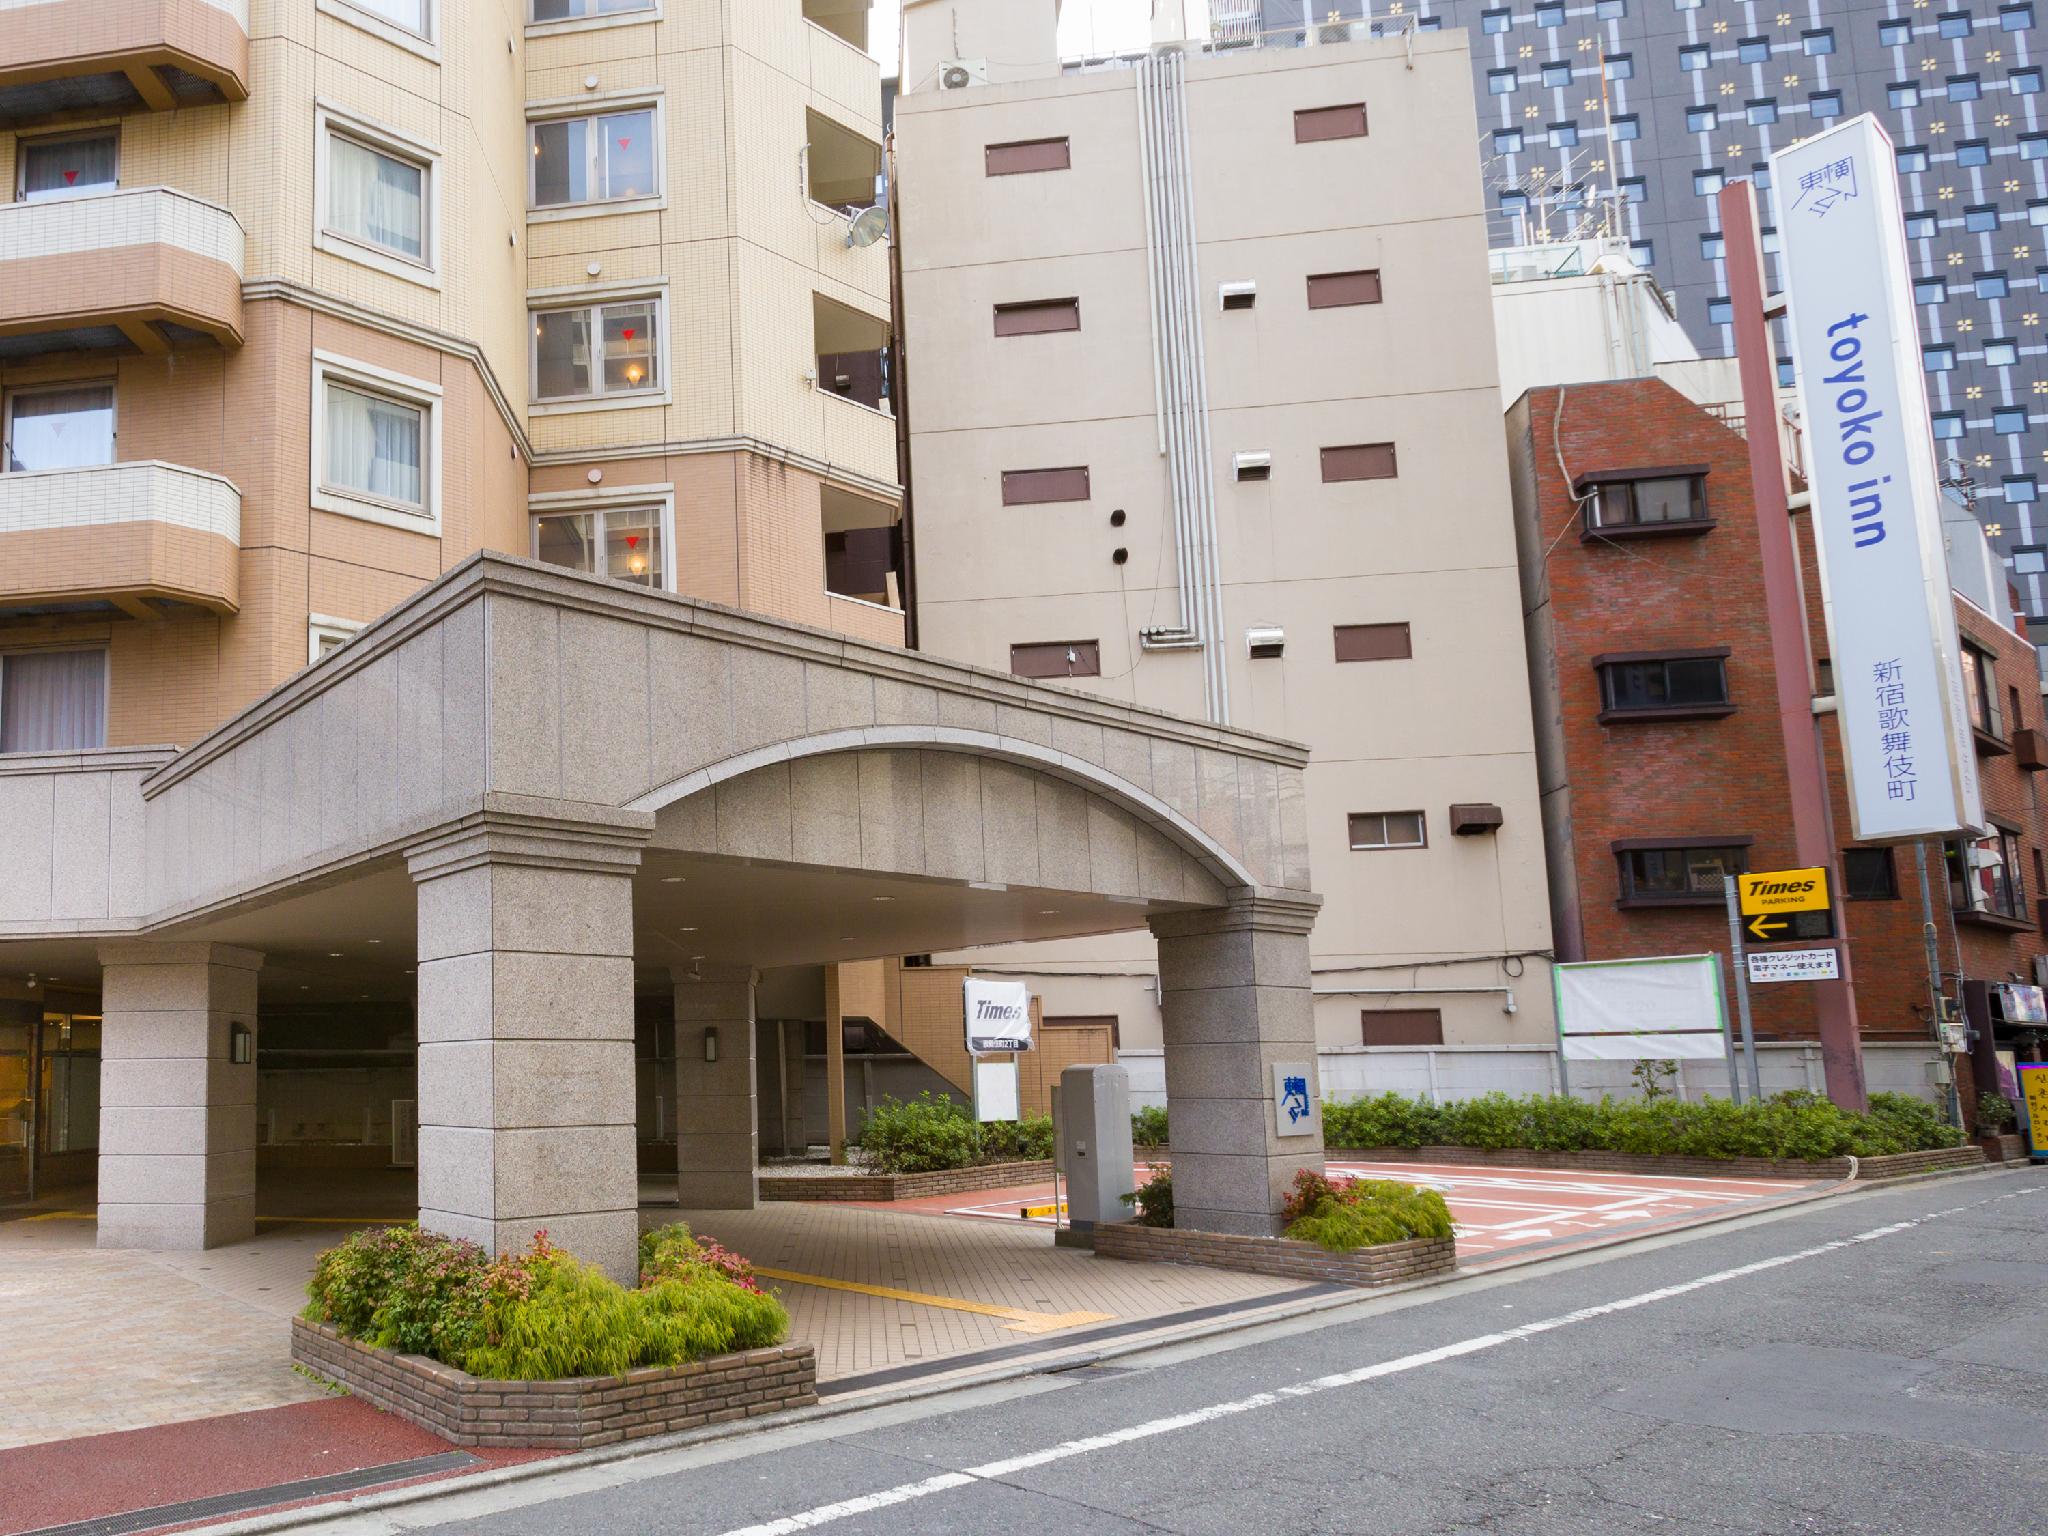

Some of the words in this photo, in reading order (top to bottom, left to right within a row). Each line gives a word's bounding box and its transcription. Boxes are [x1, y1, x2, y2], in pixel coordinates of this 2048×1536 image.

[1823, 312, 1883, 465] toyoko
[1848, 474, 1892, 548] inn
[1872, 657, 1917, 801] 新宿歌舞伎町
[1749, 880, 1815, 896] Times
[1761, 896, 1805, 905] PARKING
[1751, 952, 1833, 963] 各種クレジットカード
[1753, 961, 1832, 972] 電子マネー使えます
[976, 1000, 1021, 1019] Times
